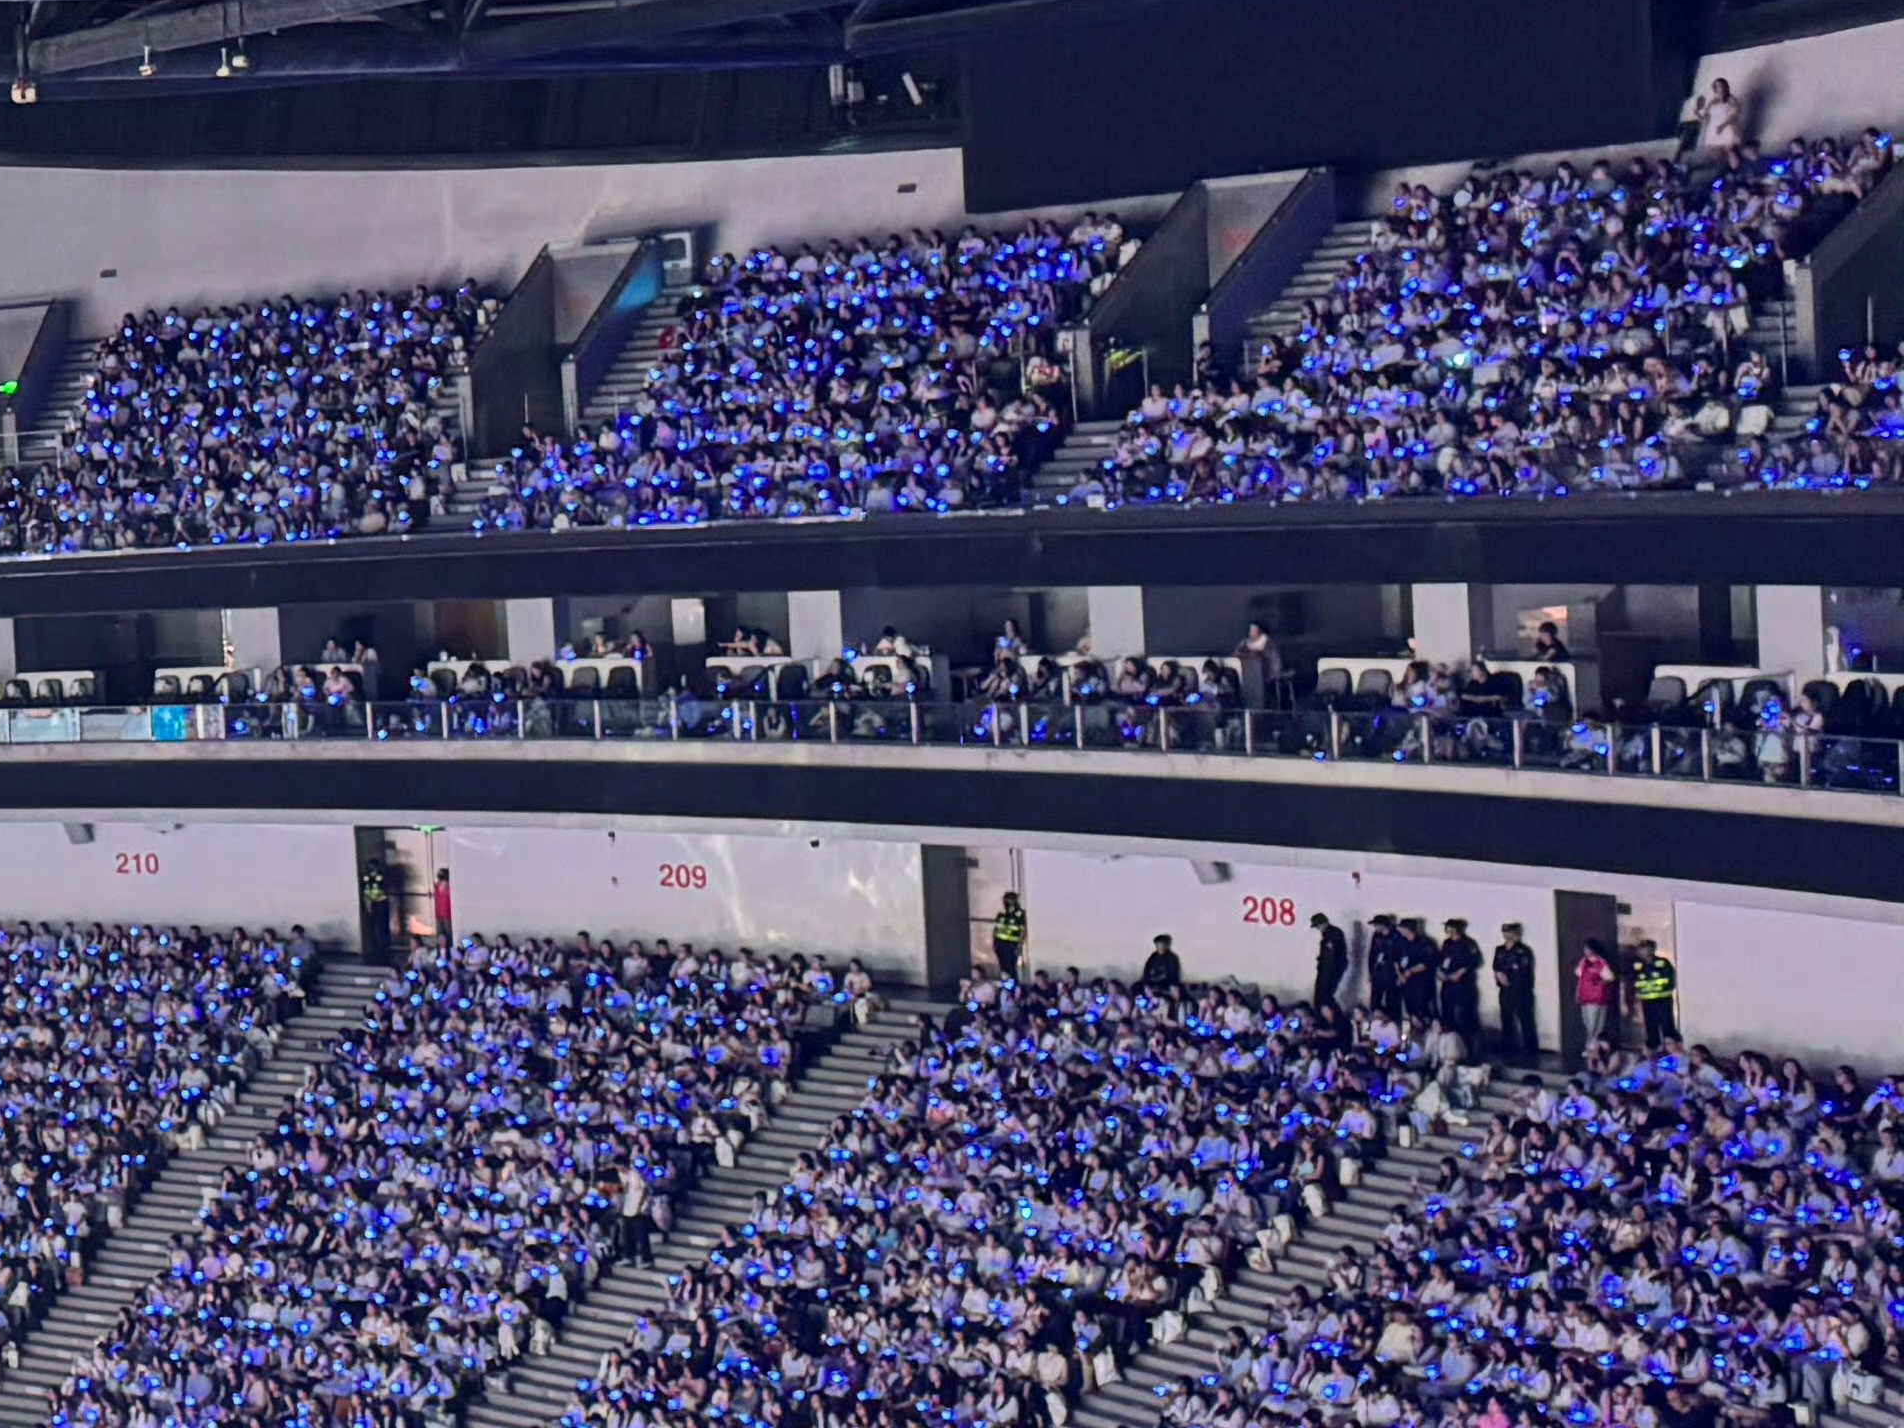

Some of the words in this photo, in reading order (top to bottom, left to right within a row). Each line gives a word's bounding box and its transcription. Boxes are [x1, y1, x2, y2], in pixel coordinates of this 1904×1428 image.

[115, 851, 161, 877] 210
[659, 863, 709, 891] 209
[1242, 895, 1297, 929] 208
